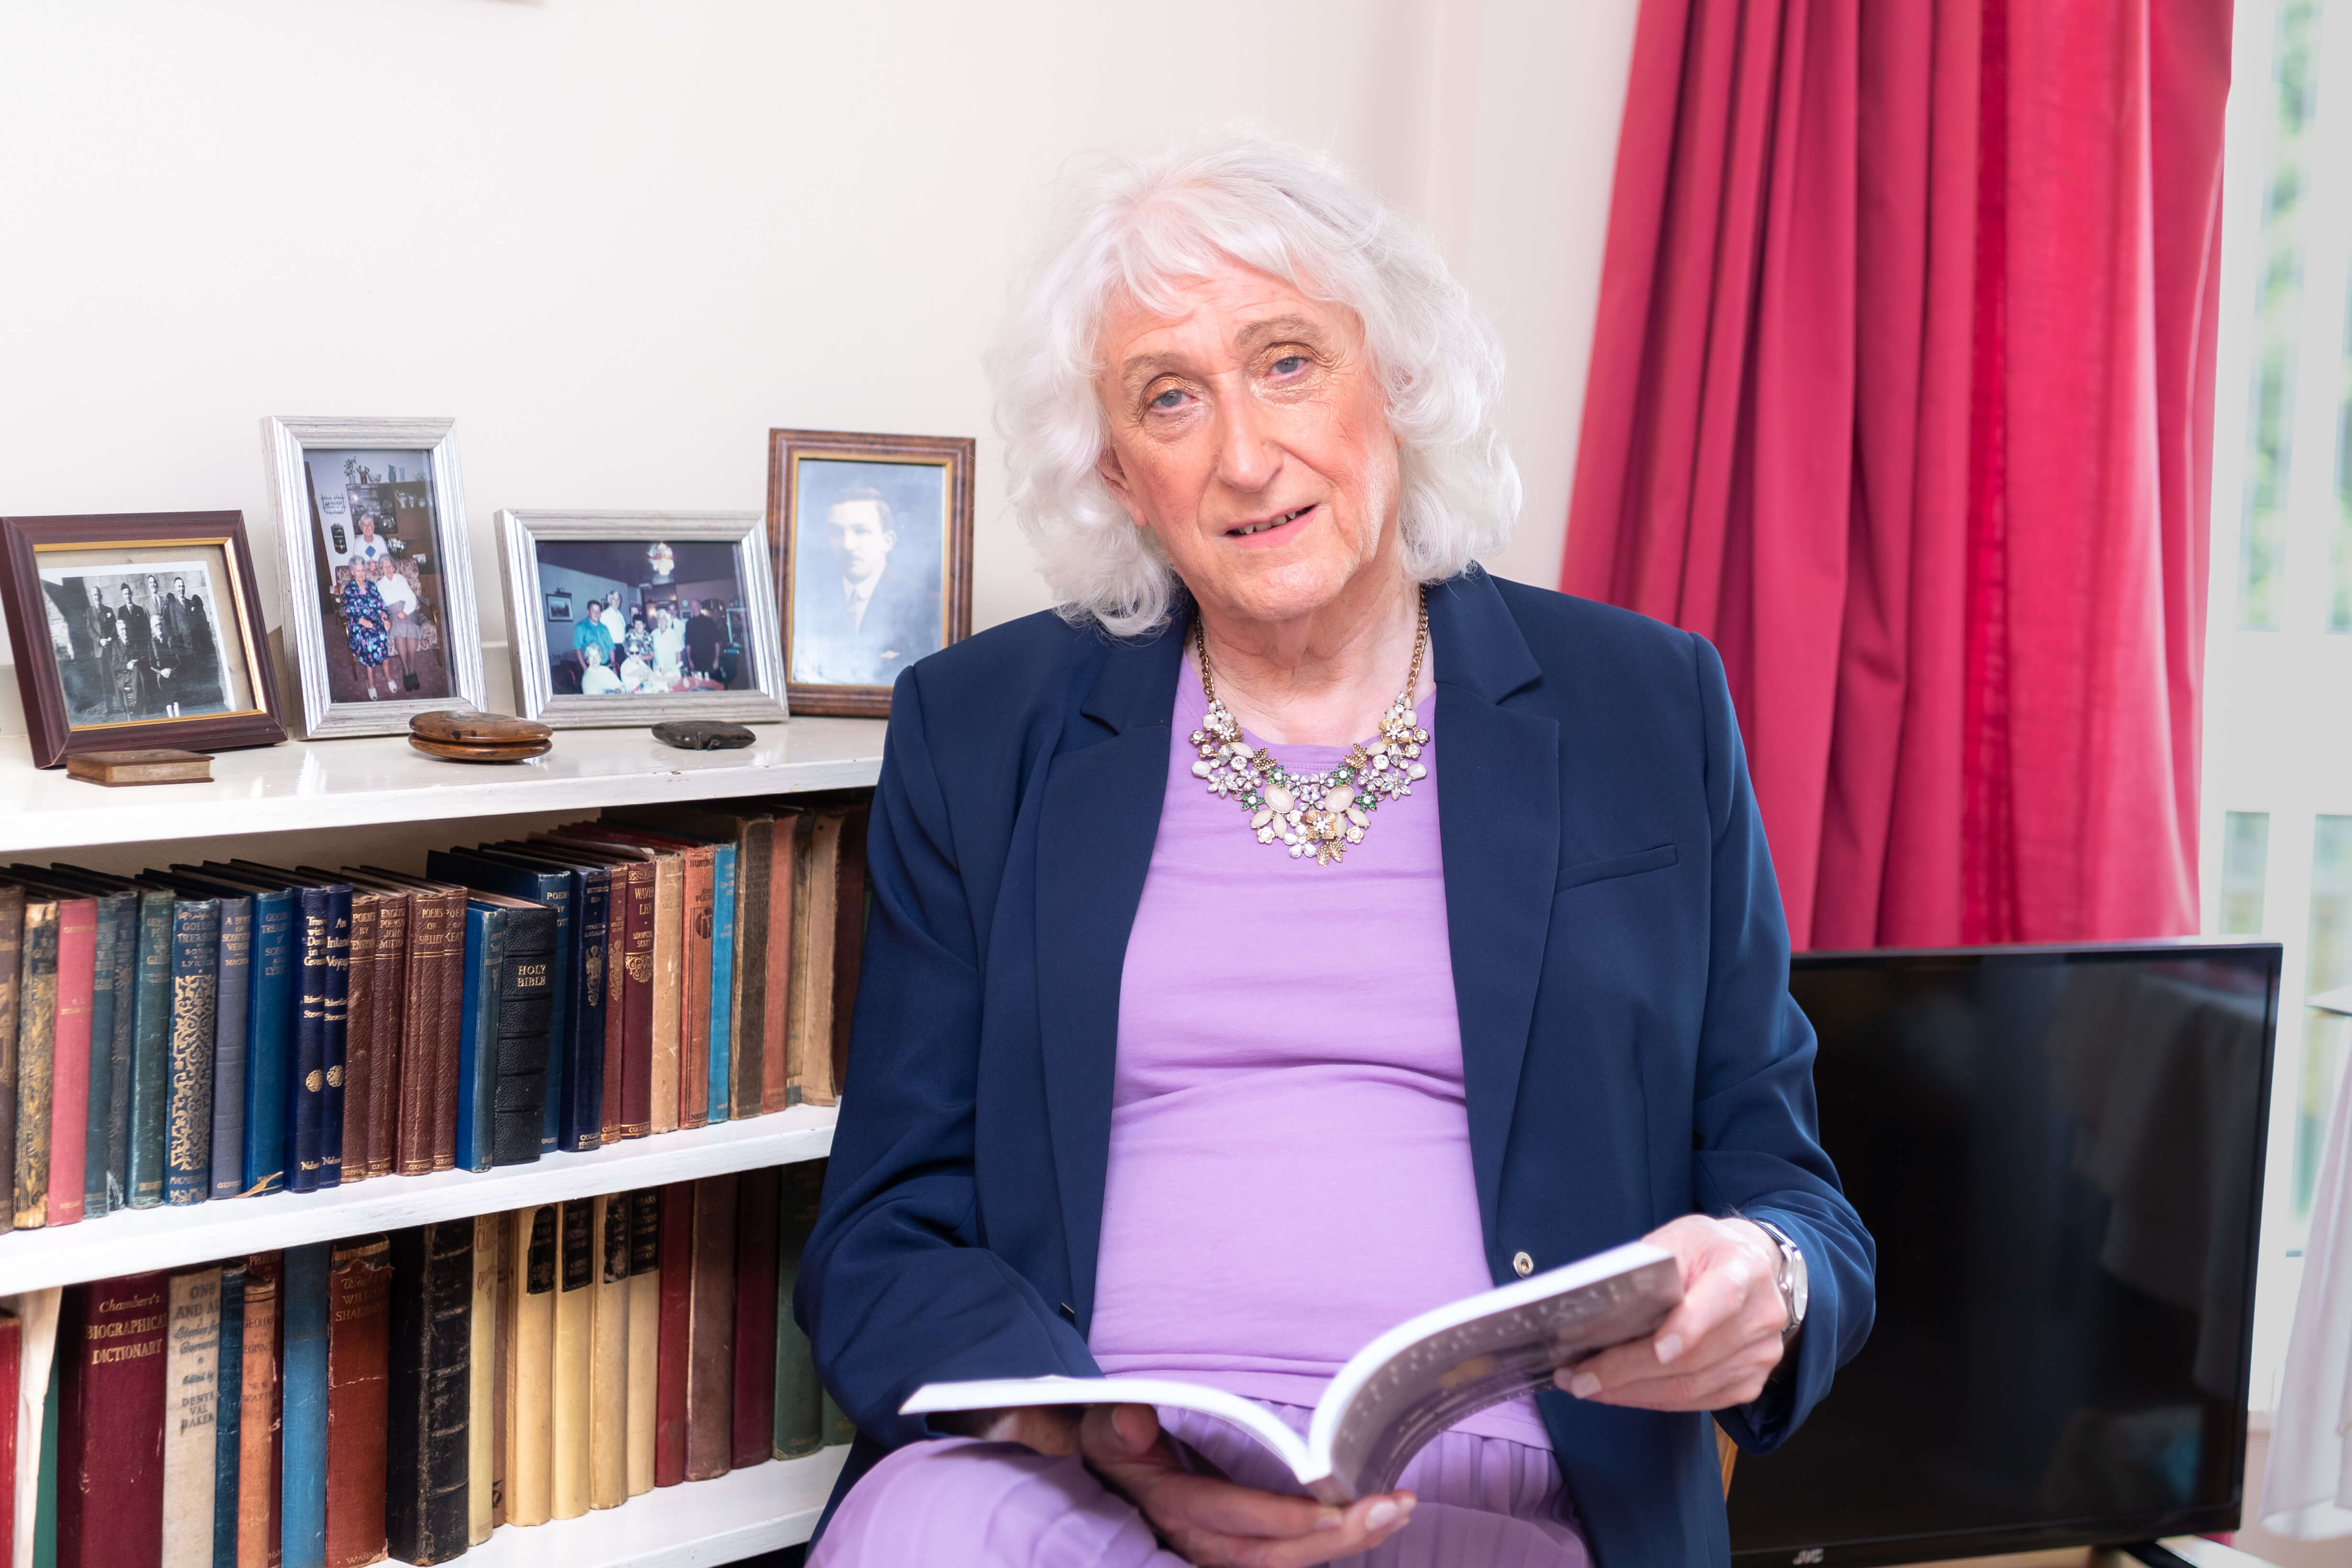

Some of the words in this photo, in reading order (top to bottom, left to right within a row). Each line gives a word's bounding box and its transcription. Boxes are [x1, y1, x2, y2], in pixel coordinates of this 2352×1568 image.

[422, 908, 443, 919] POEMS
[639, 903, 652, 915] LEY
[225, 917, 233, 925] A
[335, 918, 346, 928] An
[352, 912, 375, 923] POEMS
[427, 922, 436, 930] OF
[419, 934, 444, 945] SHELLEY
[518, 964, 546, 975] HOLY
[517, 976, 546, 987] BIBLE
[99, 1293, 161, 1313] Chambers's
[174, 1304, 203, 1320] AND
[91, 1338, 163, 1365] DICTIONARY
[181, 1390, 214, 1407] DENYS
[189, 1403, 207, 1415] VAL
[181, 1412, 215, 1429] BAKER
[1792, 1549, 1824, 1565] JVC
